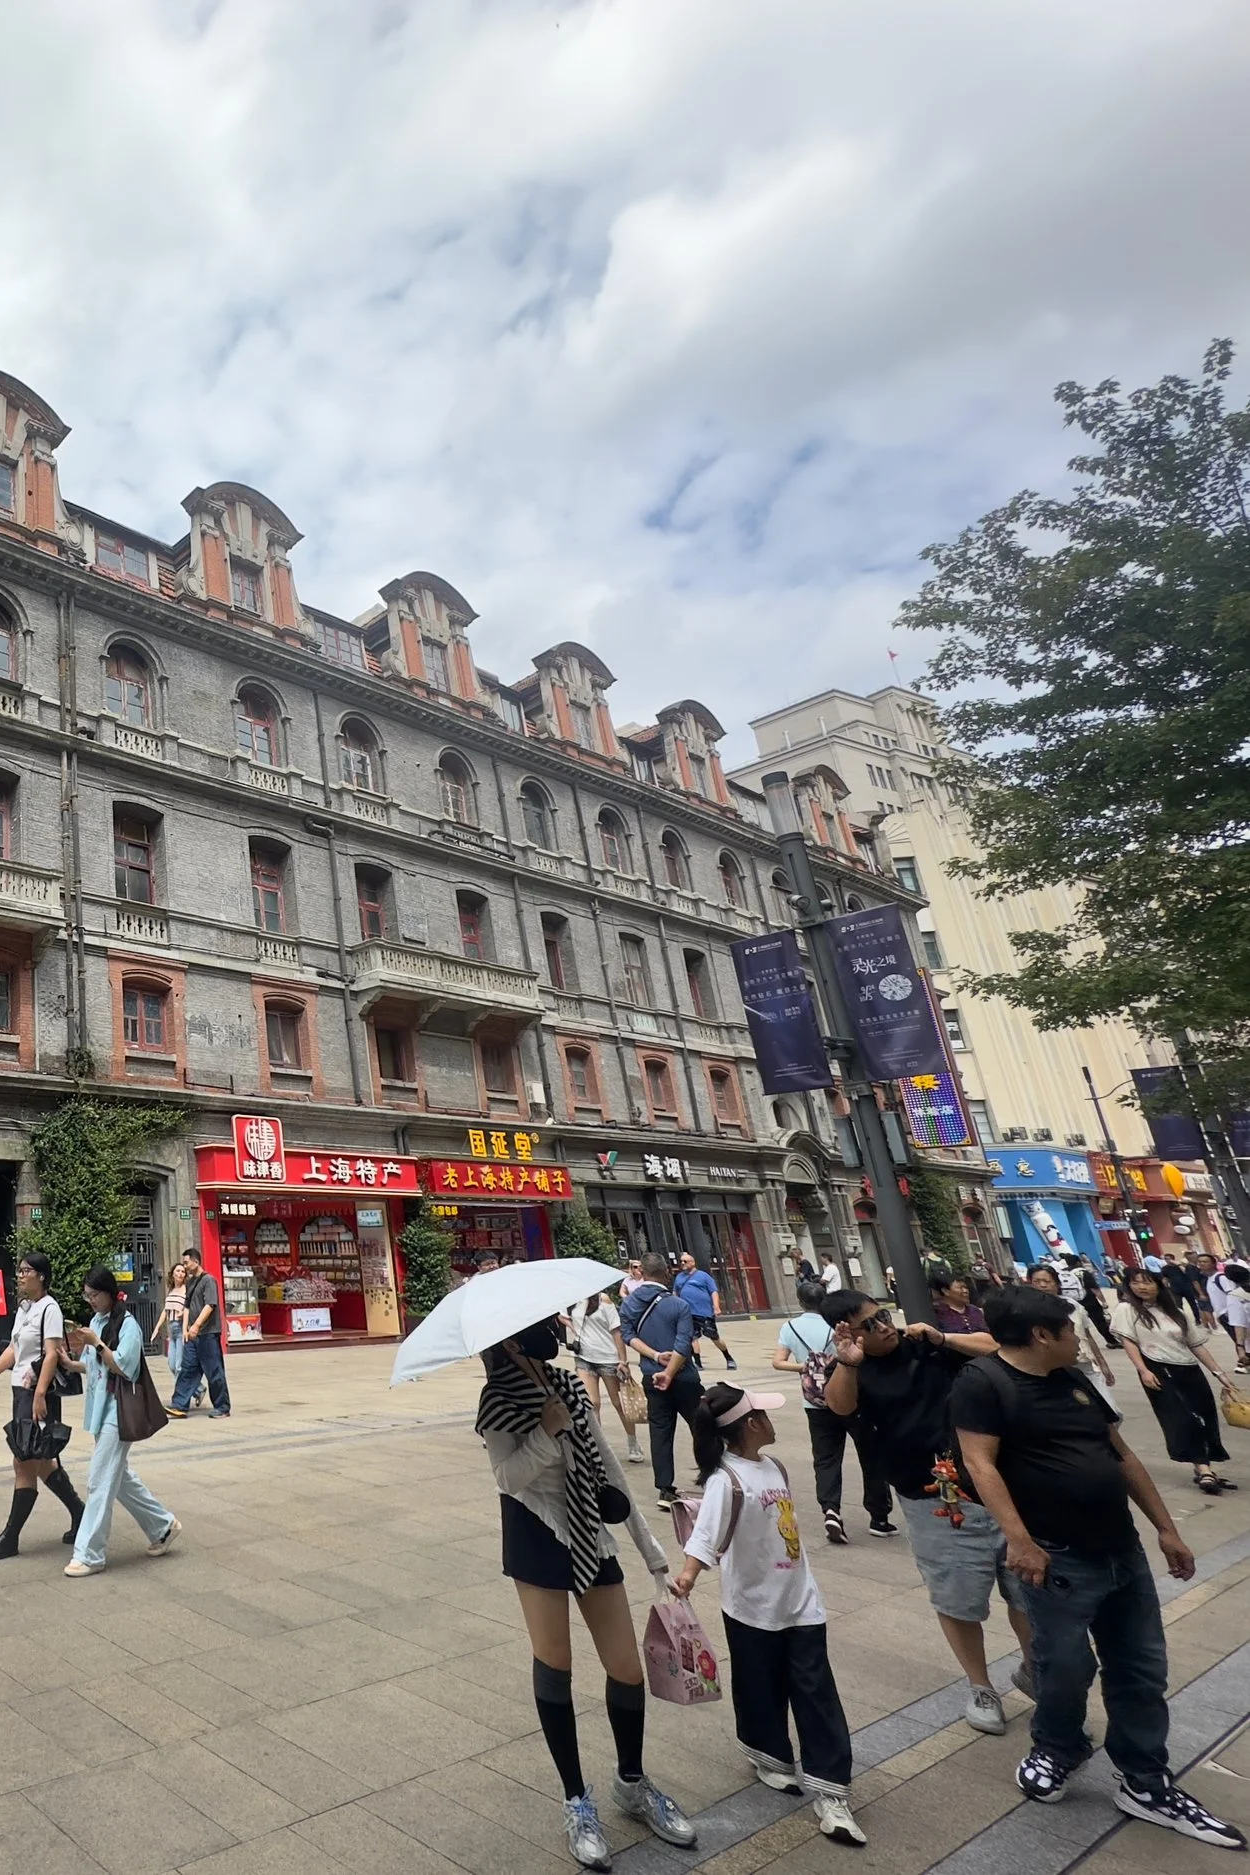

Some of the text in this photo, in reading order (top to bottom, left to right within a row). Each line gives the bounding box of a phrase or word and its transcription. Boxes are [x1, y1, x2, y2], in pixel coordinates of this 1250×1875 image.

[851, 954, 898, 975] 灵光之境
[468, 1129, 533, 1161] 国延堂
[243, 1160, 283, 1180] 味津香
[302, 1156, 403, 1185] 上海特产
[442, 1162, 567, 1194] 老上海特产铺子
[709, 1166, 738, 1178] HAIYAN
